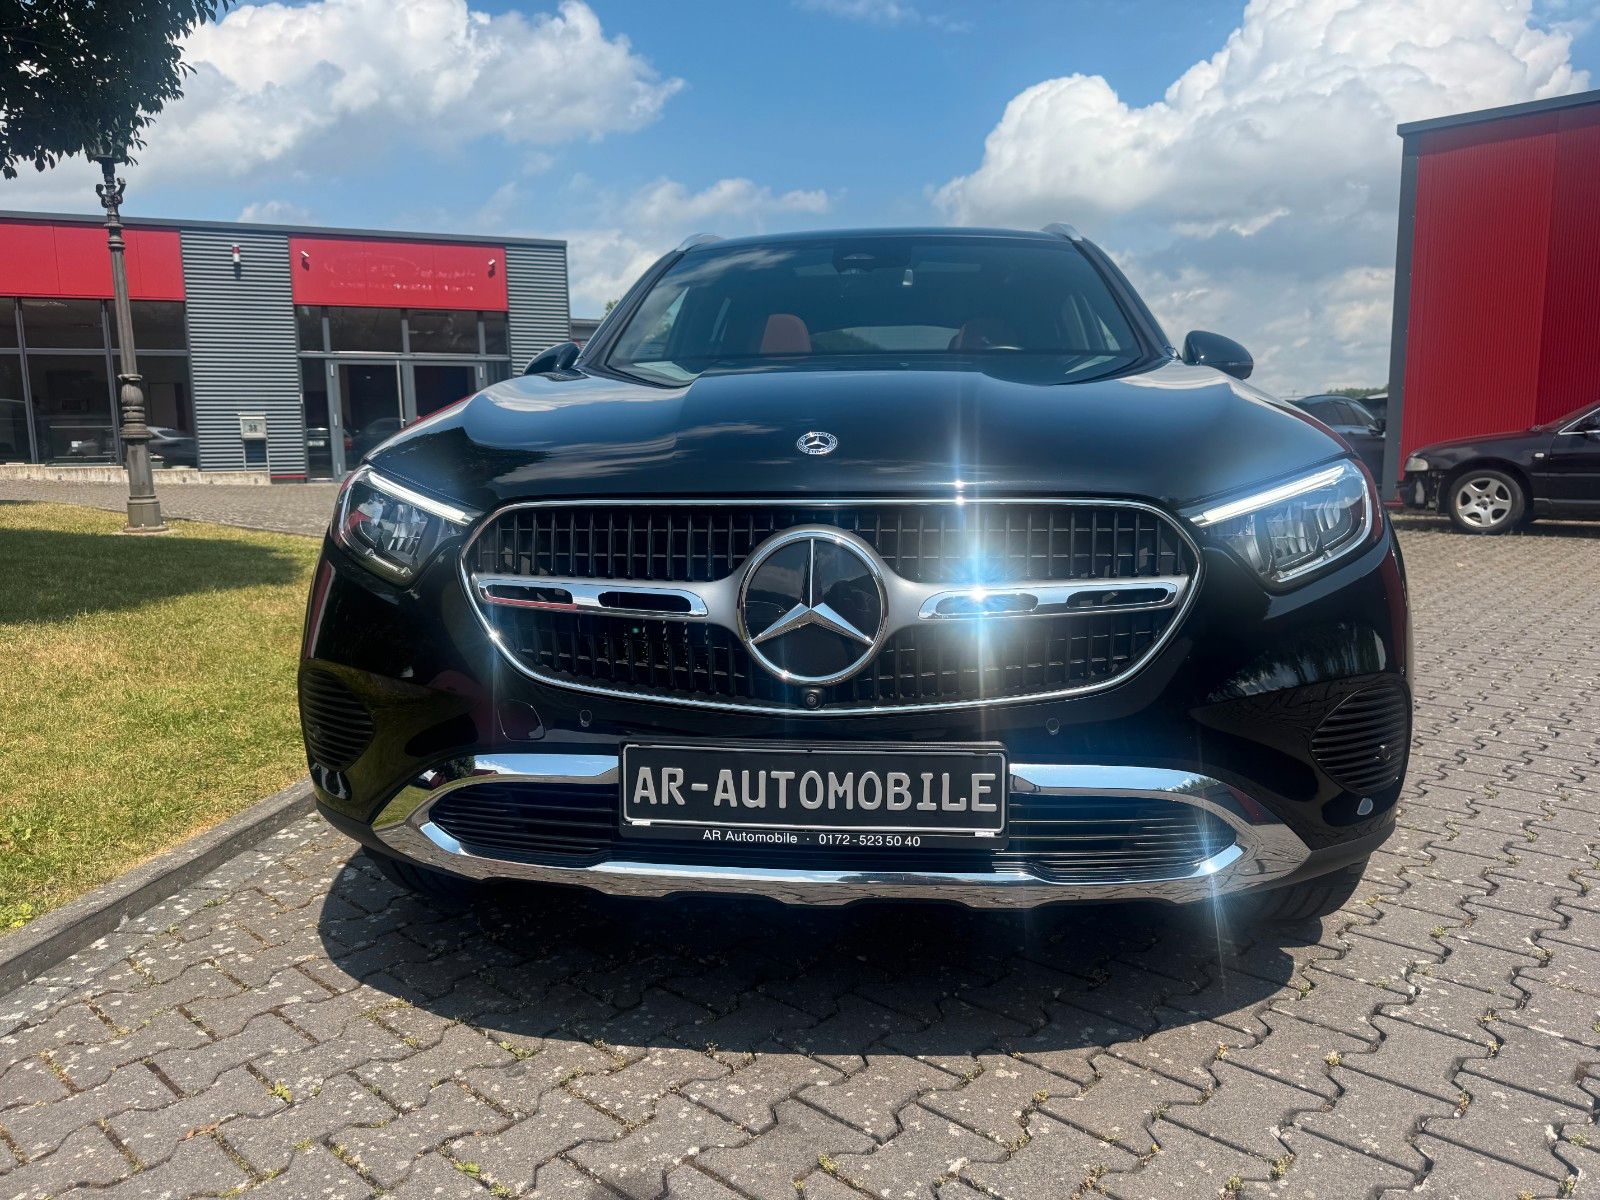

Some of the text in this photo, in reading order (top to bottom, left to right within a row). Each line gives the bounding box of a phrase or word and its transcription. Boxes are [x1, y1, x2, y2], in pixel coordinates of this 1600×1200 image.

[633, 766, 998, 812] AR-AUTOMOBILE
[702, 829, 721, 842] AR
[725, 830, 798, 844] Automobile
